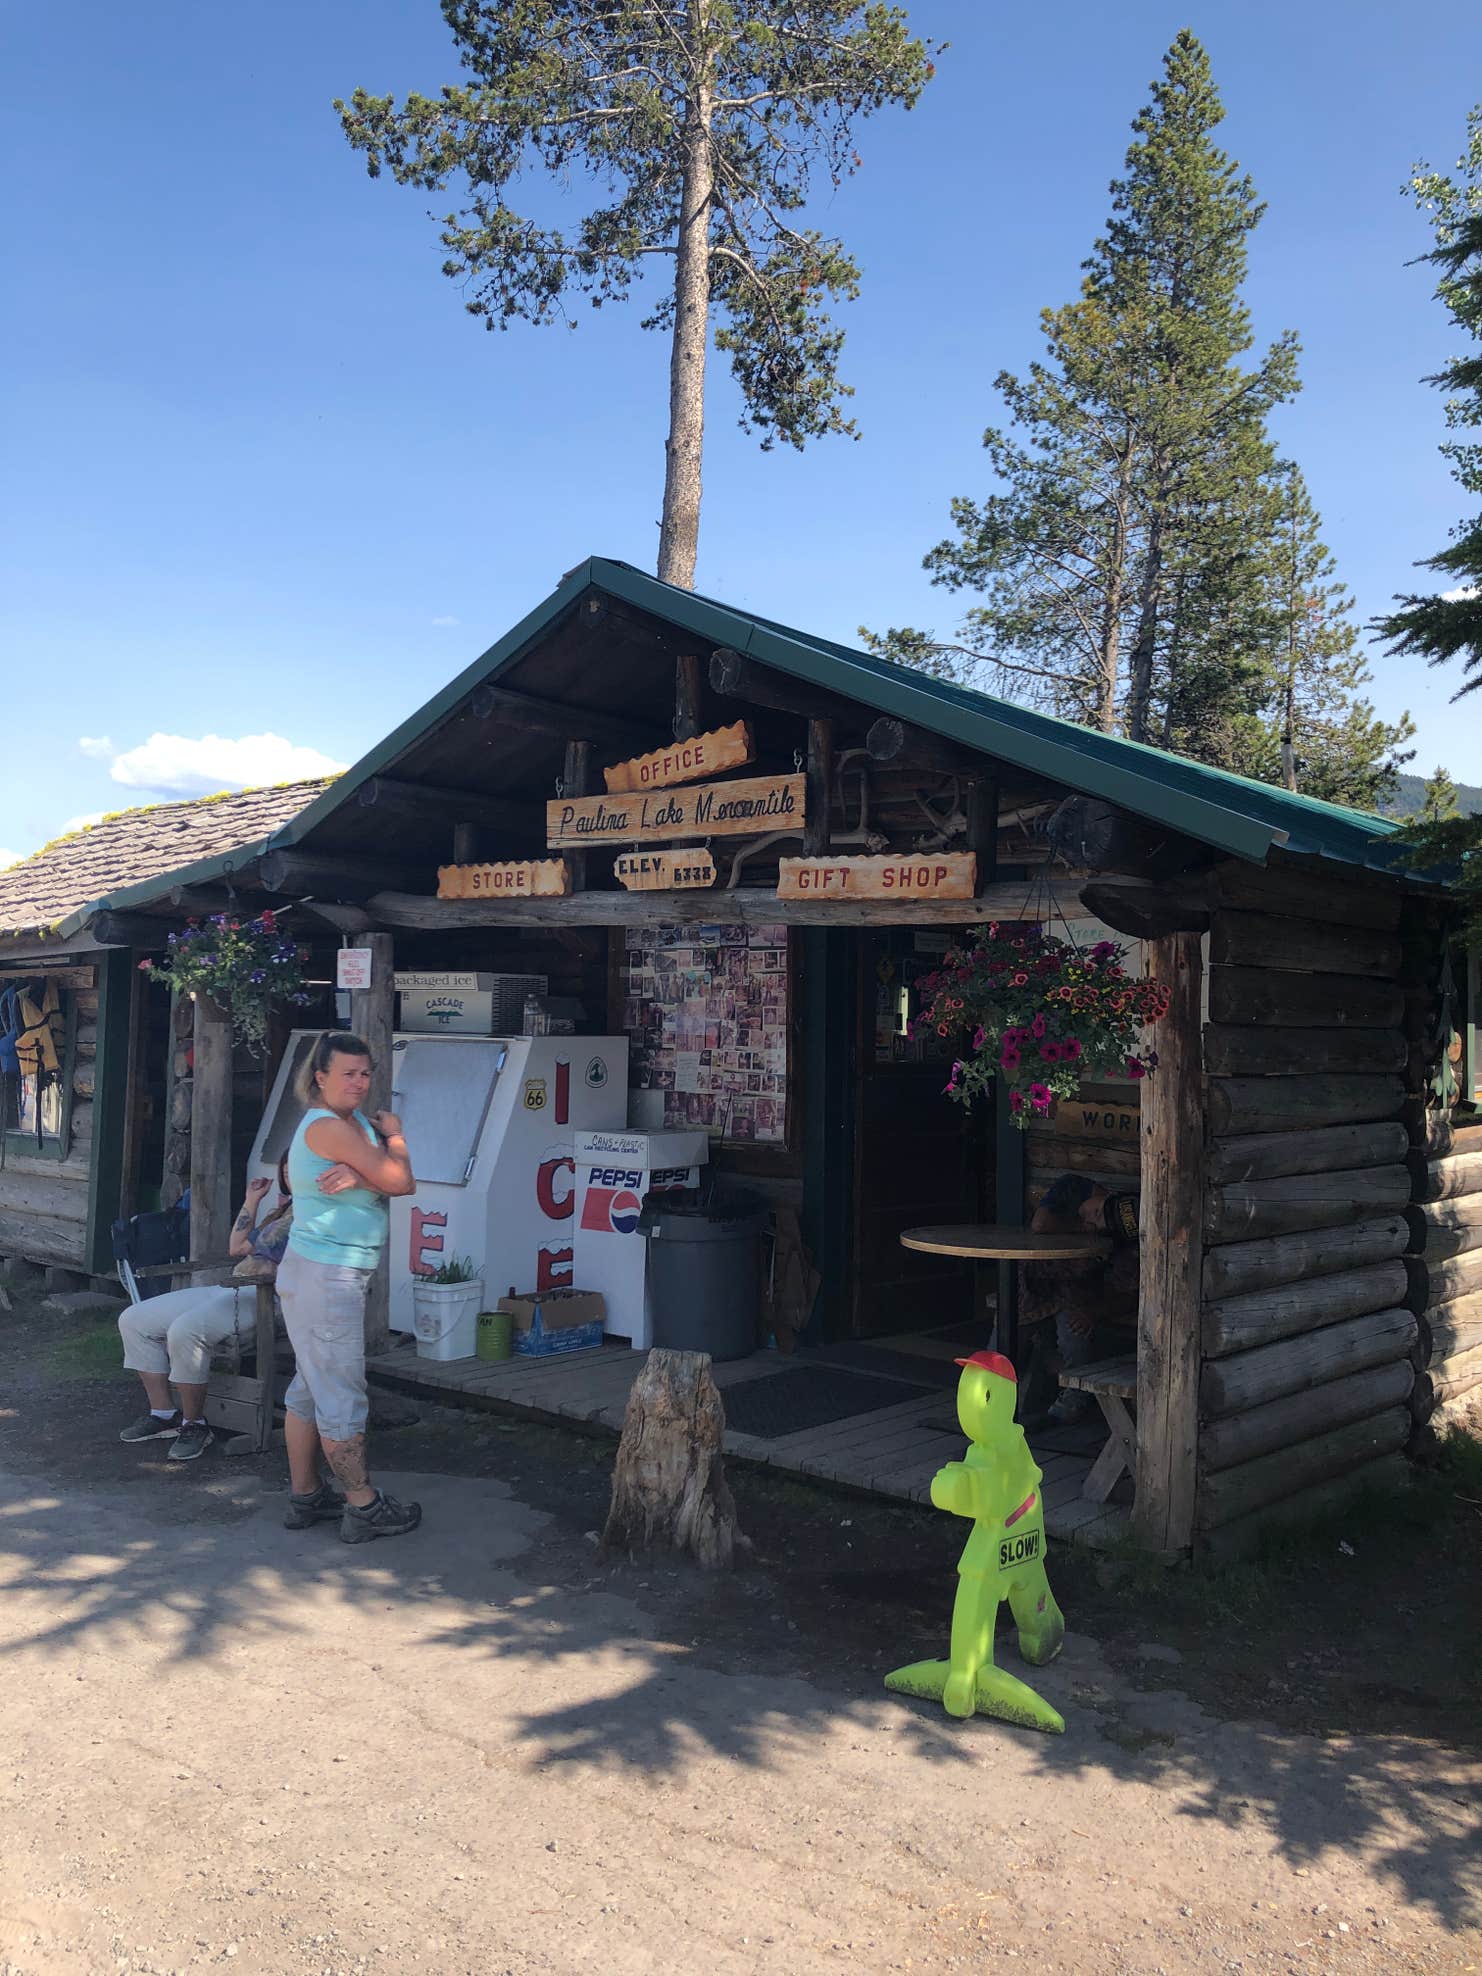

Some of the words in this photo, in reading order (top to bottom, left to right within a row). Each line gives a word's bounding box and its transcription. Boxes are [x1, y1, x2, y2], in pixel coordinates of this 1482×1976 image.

[640, 745, 704, 783] OFFICE
[560, 806, 628, 836] Paulina
[641, 798, 684, 829] Lake
[695, 785, 795, 825] Mercantile
[618, 857, 665, 875] ELEV.
[472, 870, 525, 890] STORE
[799, 868, 850, 889] GIFT
[882, 866, 949, 888] SHOP
[393, 974, 450, 988] packaged
[454, 975, 472, 986] ice
[426, 997, 464, 1009] CASCADE
[438, 1016, 451, 1025] ICE
[527, 1091, 543, 1106] 66
[593, 1134, 612, 1147] CANS
[588, 1167, 643, 1189] PEPSI
[1000, 1533, 1038, 1565] SLOW!
